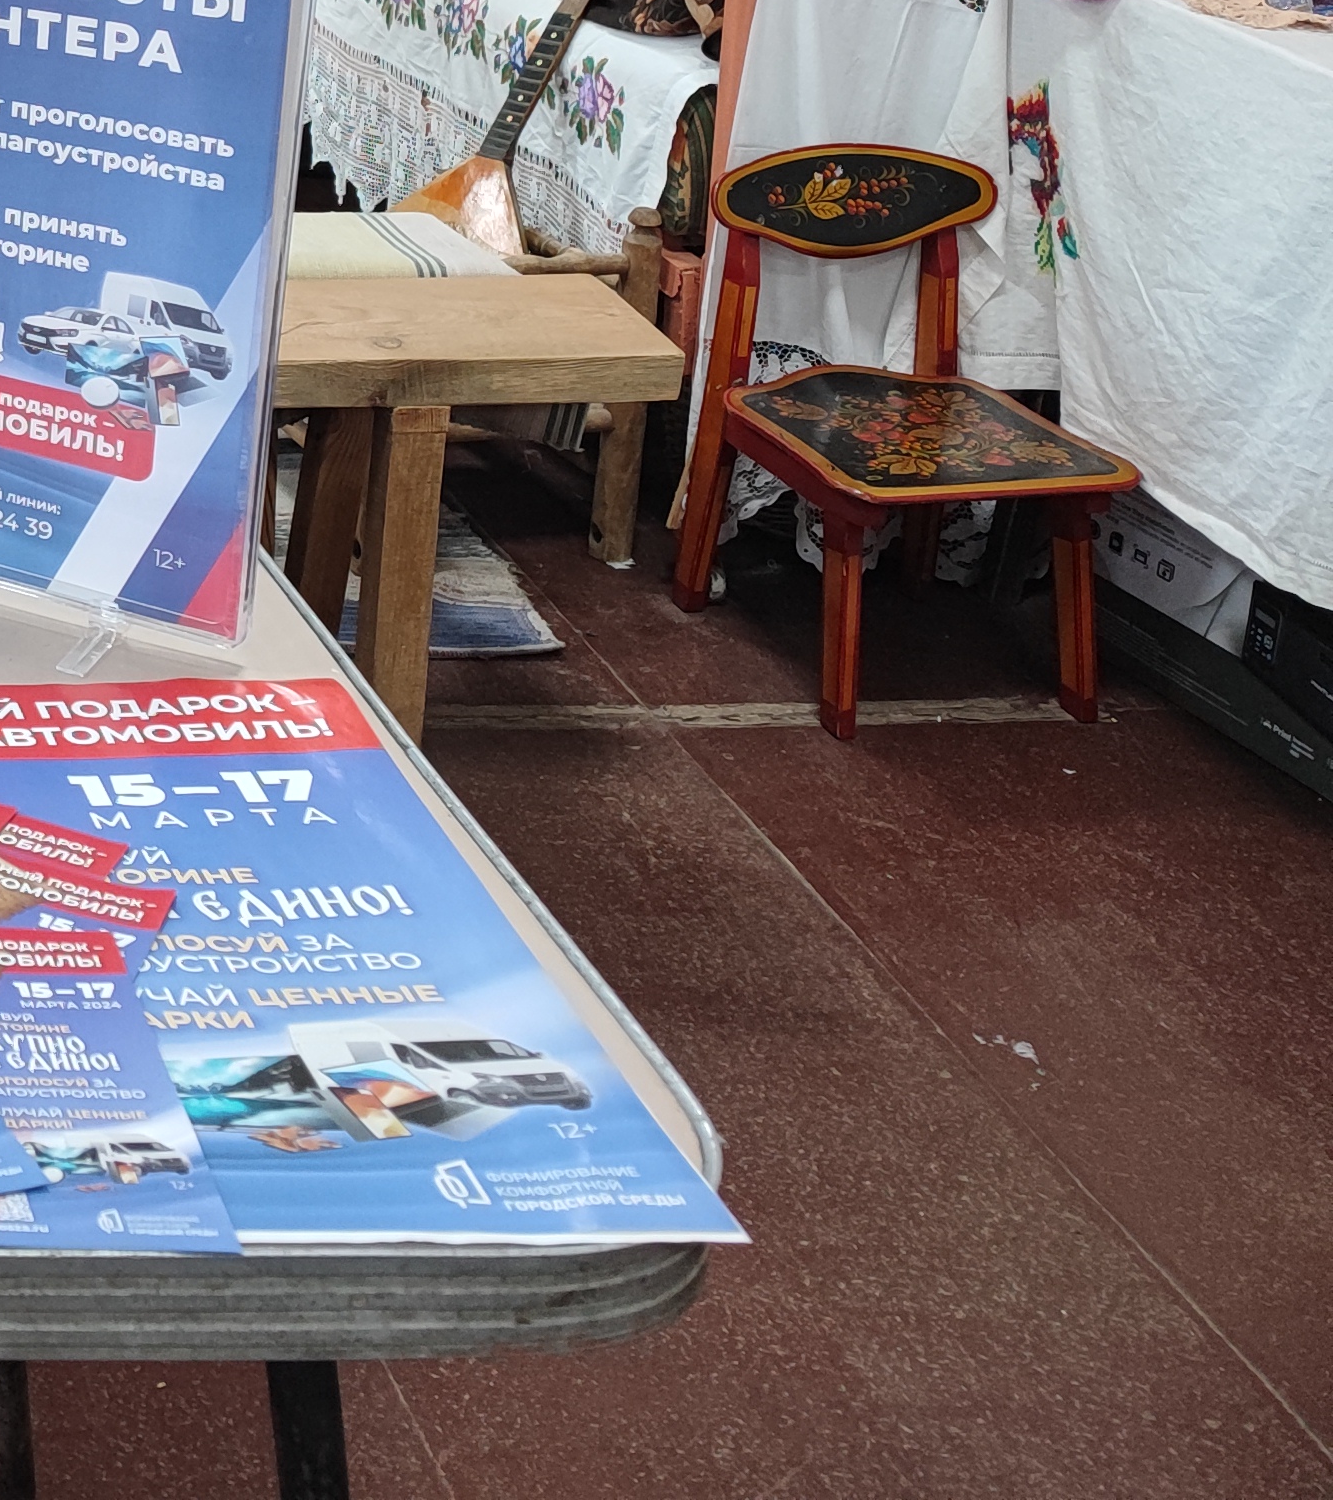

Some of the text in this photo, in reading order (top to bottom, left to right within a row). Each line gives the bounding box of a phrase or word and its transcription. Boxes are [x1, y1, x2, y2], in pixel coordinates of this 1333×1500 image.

[11, 100, 235, 160] проголосовать
[4, 209, 128, 248] принять
[0, 390, 98, 431] подарок
[5, 487, 61, 516] линии:
[24, 515, 53, 540] 39
[153, 549, 186, 572] 12+
[35, 694, 282, 723] ПОДАРОК
[89, 807, 337, 829] МАРТА
[106, 867, 259, 885] ОРИНЕ
[296, 934, 354, 951] ЗА
[248, 985, 445, 1008] ЦЕННЫЕ
[548, 1123, 598, 1139] 12+
[486, 1166, 641, 1183] ФОРМИРОВАНИЕ
[494, 1179, 623, 1197] КОМФОРТНОЙ
[504, 1193, 686, 1212] ГОРОДСКОЙ СРЕДЫ
